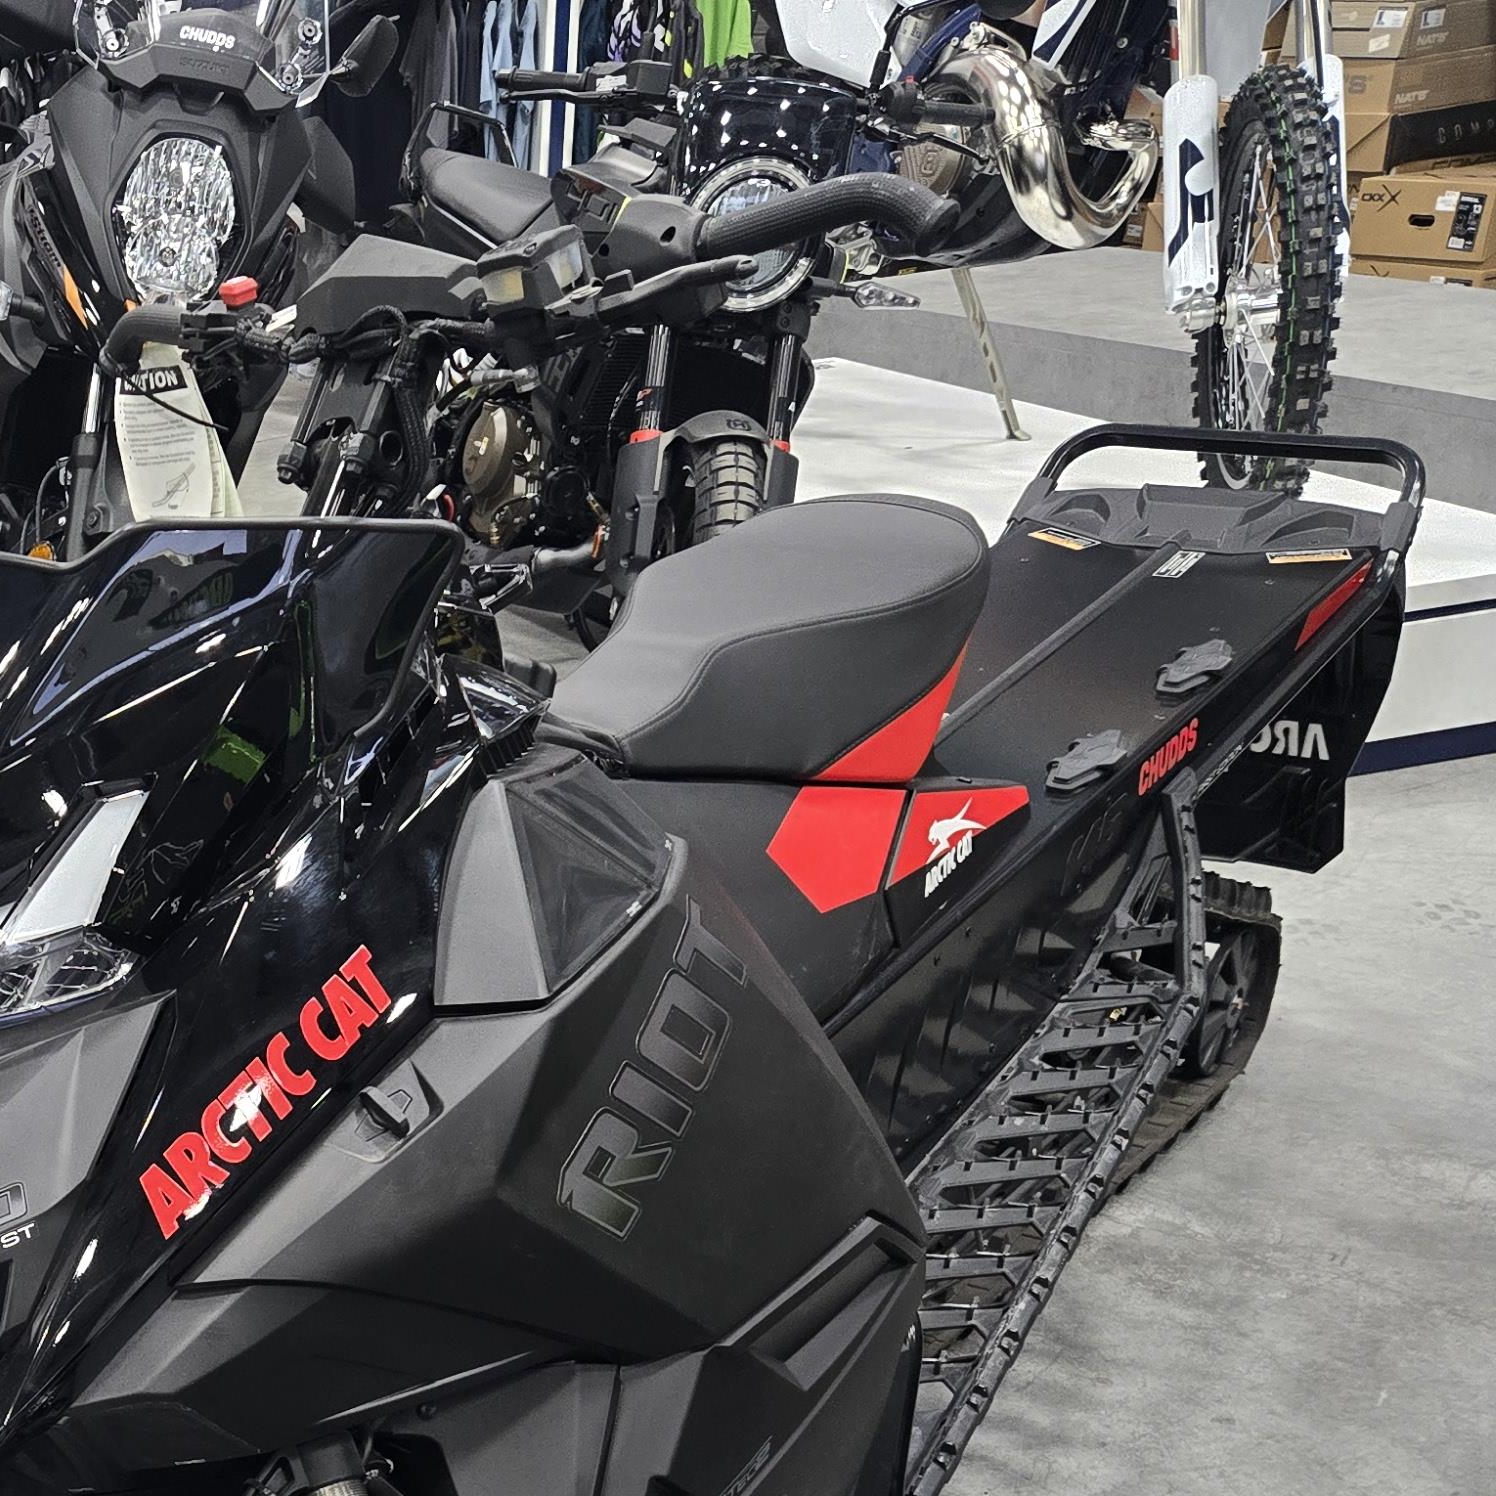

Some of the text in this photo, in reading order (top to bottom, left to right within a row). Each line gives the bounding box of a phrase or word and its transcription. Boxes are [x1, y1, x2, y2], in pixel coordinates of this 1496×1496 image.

[179, 25, 236, 49] CHUDDS
[1137, 716, 1199, 797] CHUDDS
[924, 829, 974, 898] ARCTIC CAT
[137, 944, 393, 1239] ARCTIC CAT
[556, 893, 748, 1242] RIOT
